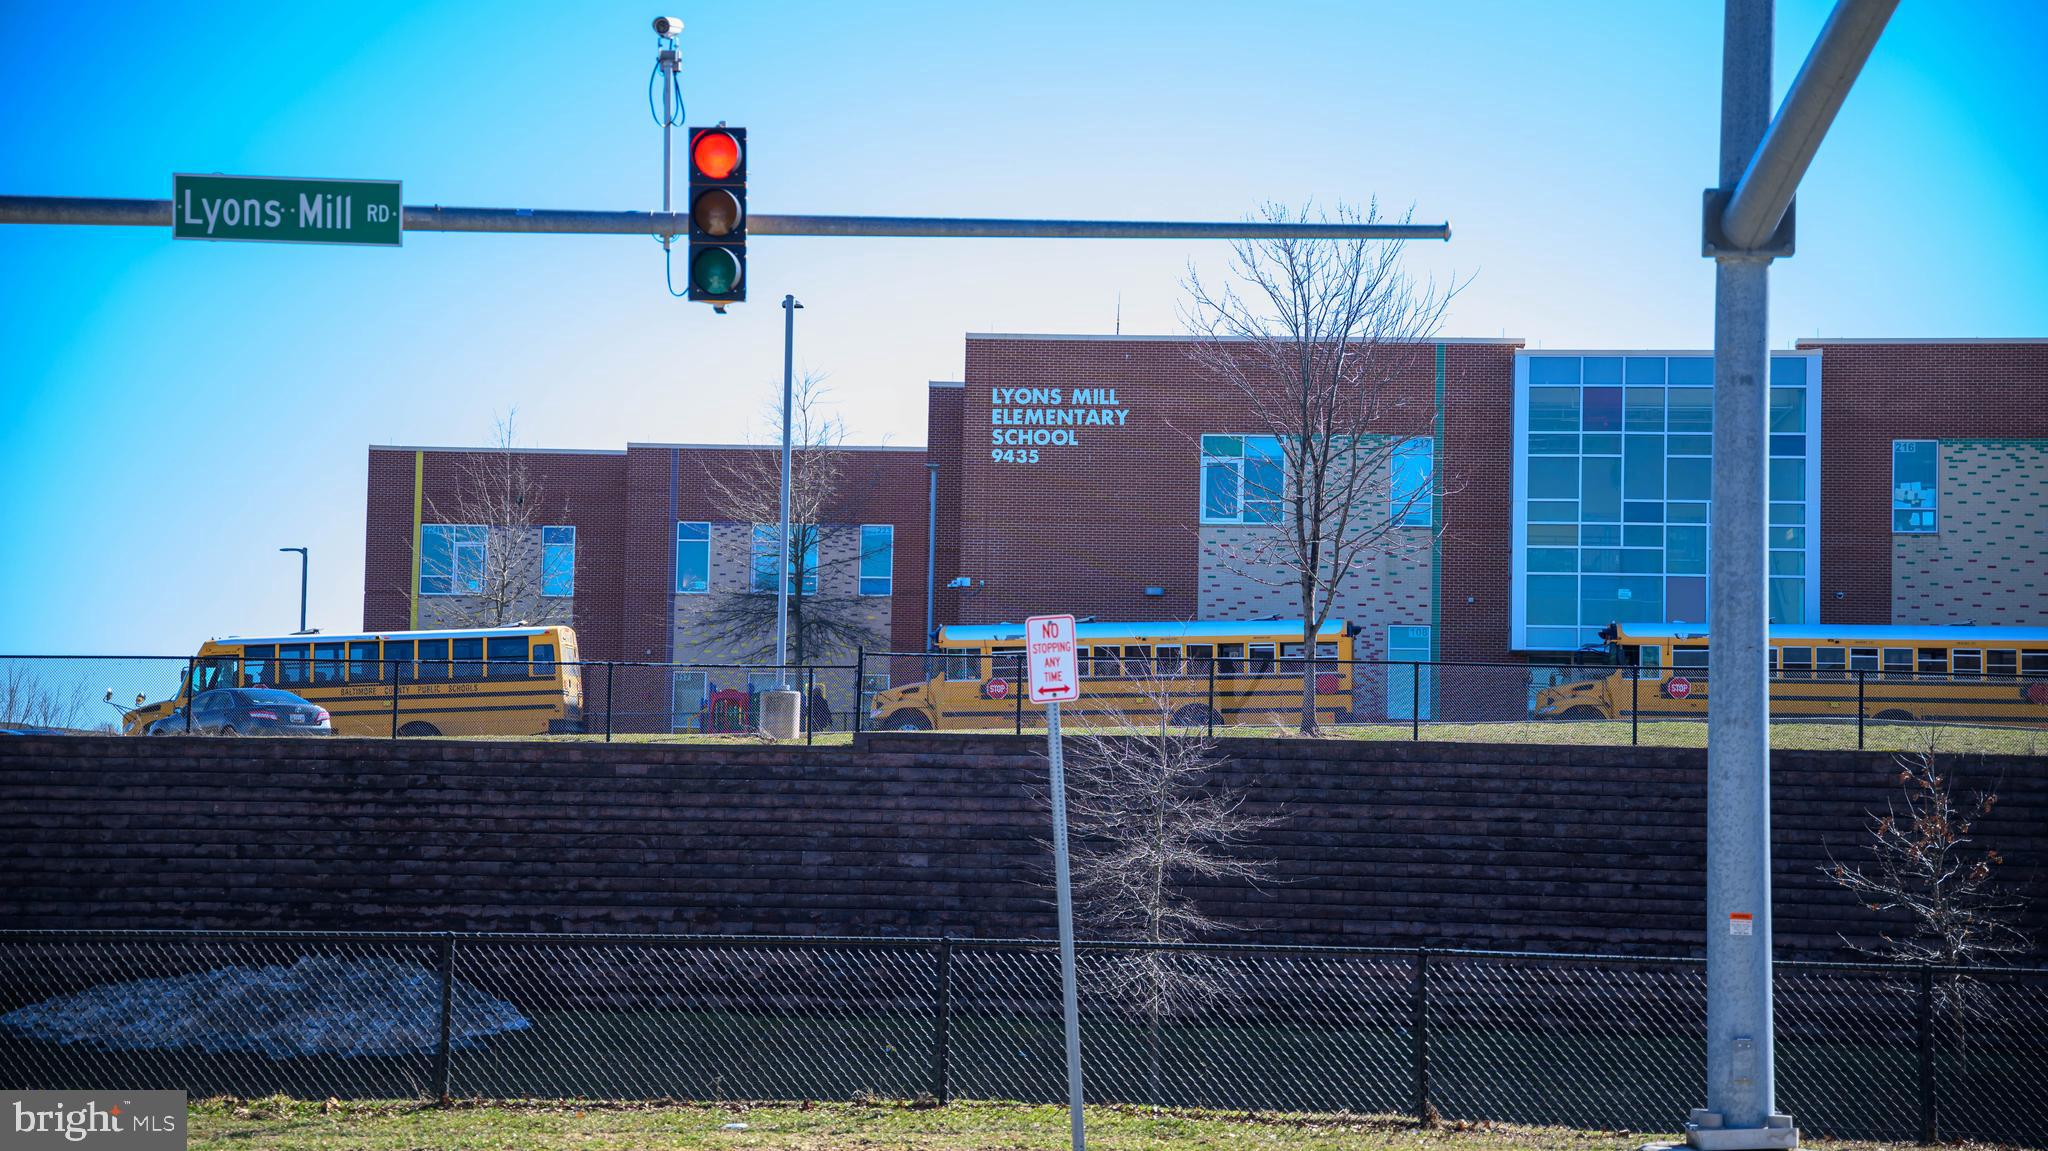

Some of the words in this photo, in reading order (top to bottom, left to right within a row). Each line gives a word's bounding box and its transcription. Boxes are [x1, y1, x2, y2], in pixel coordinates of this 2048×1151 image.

[184, 189, 282, 234] Lyons
[299, 193, 352, 230] Mill
[366, 204, 390, 223] RD
[991, 387, 1062, 405] LYONS
[1071, 388, 1120, 405] MILL
[991, 408, 1130, 426] ELEMENTARY
[991, 428, 1079, 446] SCHOOL
[1894, 441, 1915, 452] 216
[991, 448, 1040, 464] 9435
[1041, 623, 1059, 639] NO
[1032, 641, 1071, 655] STOPPING
[1044, 656, 1061, 668] ANY
[1043, 671, 1063, 683] TIME
[340, 686, 377, 696] BALTIMORE
[384, 685, 410, 695] CONTY
[417, 684, 441, 694] PUBLIC
[447, 683, 479, 693] SCHOOLS
[989, 684, 1006, 693] STOP
[1671, 683, 1688, 692] STOP
